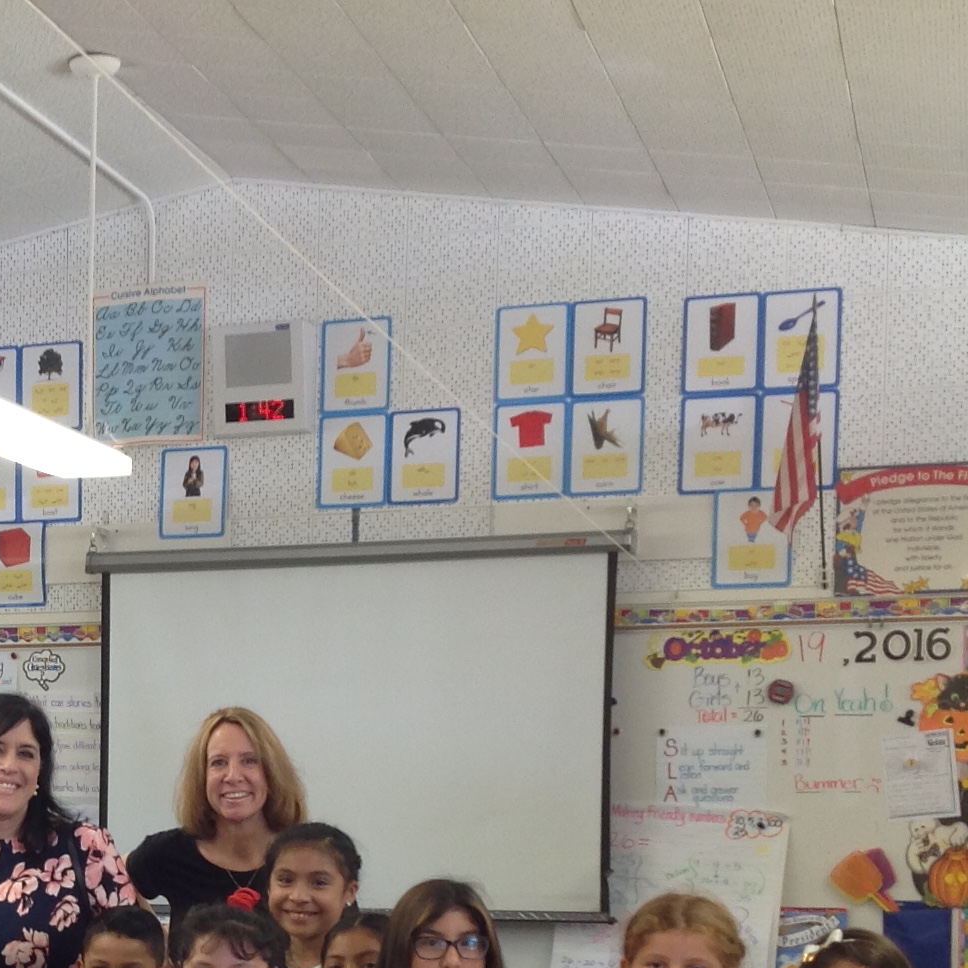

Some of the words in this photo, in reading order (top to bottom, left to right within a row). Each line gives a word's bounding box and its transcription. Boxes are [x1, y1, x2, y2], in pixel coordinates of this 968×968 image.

[144, 286, 186, 296] Alphabet
[918, 471, 930, 481] to
[934, 470, 954, 480] The
[799, 632, 825, 662] 19
[694, 666, 730, 689] Boys
[748, 668, 765, 686] 13
[67, 697, 92, 708] stories
[689, 689, 731, 709] Girls
[747, 689, 765, 706] 13
[696, 707, 727, 723] Total
[744, 709, 764, 723] 26
[77, 783, 90, 793] help
[794, 773, 863, 791] Bummer
